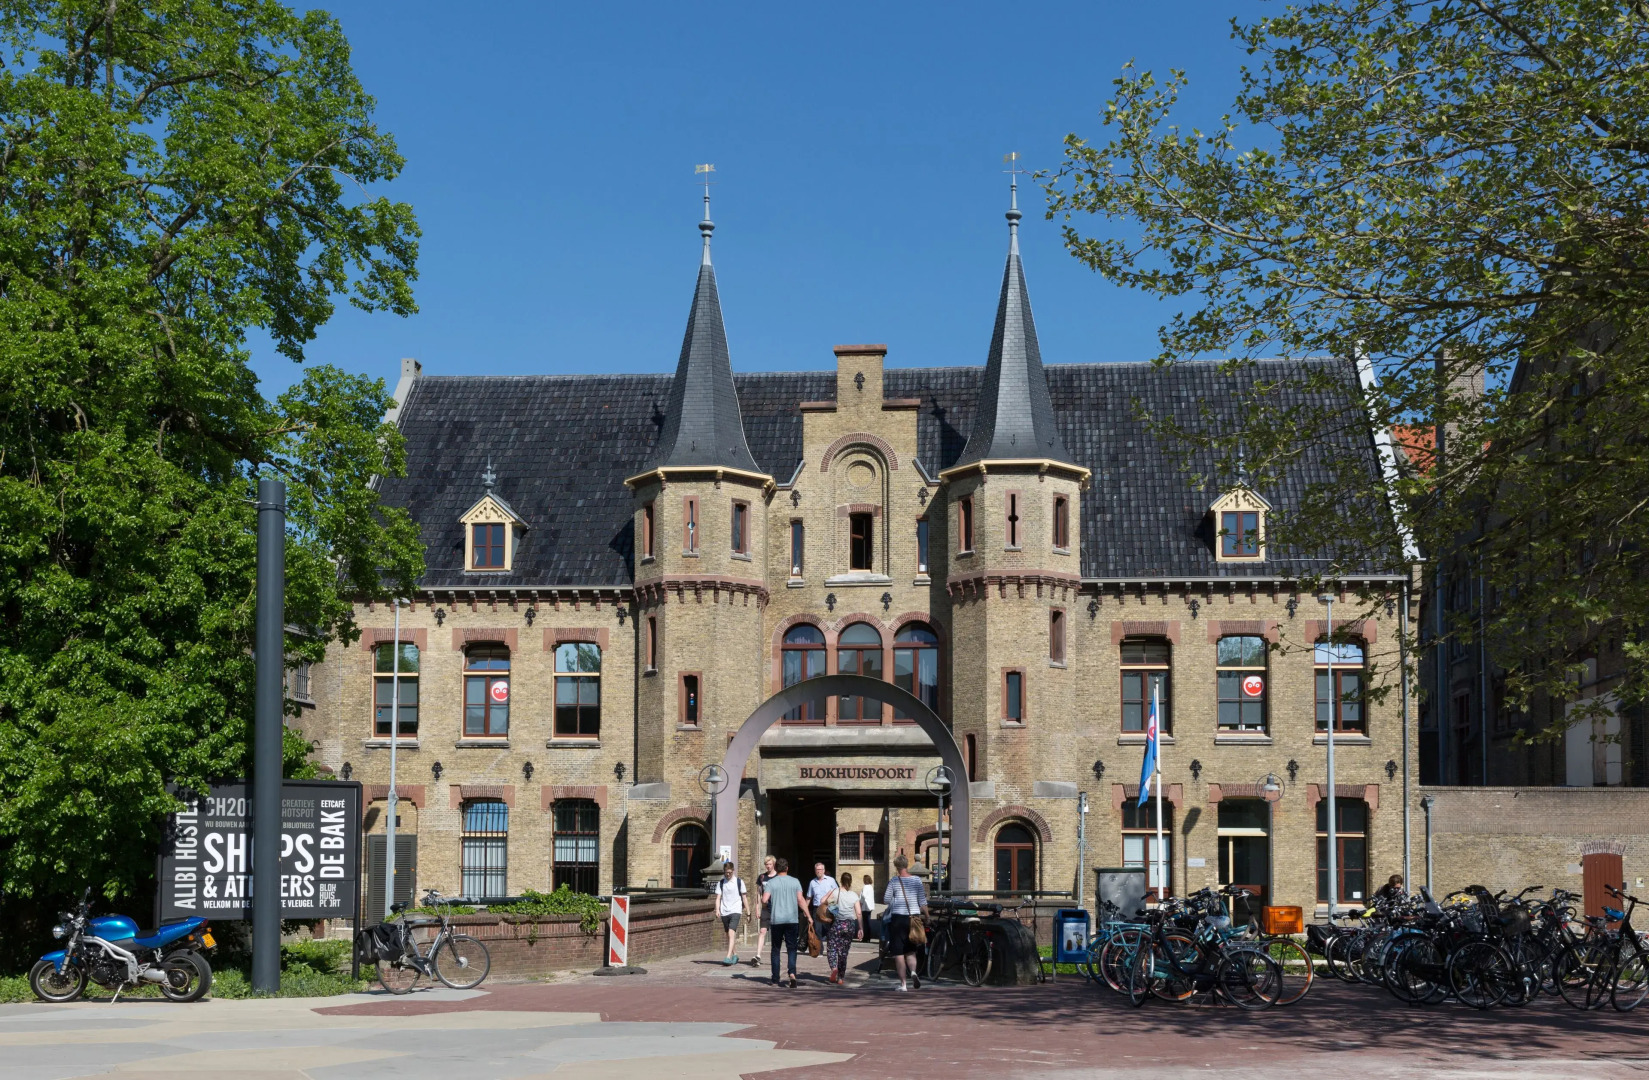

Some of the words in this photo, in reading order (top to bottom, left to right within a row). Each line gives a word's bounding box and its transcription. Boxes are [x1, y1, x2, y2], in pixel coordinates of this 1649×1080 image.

[800, 767, 914, 779] BLOKHUISPOORT
[206, 796, 253, 817] CH201
[281, 799, 315, 808] CREATIEVE
[320, 799, 345, 808] EETCAFÉ
[281, 808, 315, 818] HOTSPOT
[215, 820, 238, 829] BOUWEN
[238, 821, 250, 829] AA
[282, 821, 315, 829] BIBLIOTHEEK
[320, 810, 346, 849] BAK
[203, 832, 315, 874] SHPS
[320, 853, 345, 878] DE
[174, 867, 198, 910] ALIBI
[203, 874, 218, 898] &
[319, 891, 336, 900] HUIS
[203, 900, 231, 909] WELKOM
[232, 900, 240, 909] IN
[288, 899, 315, 908] VLEUGEL
